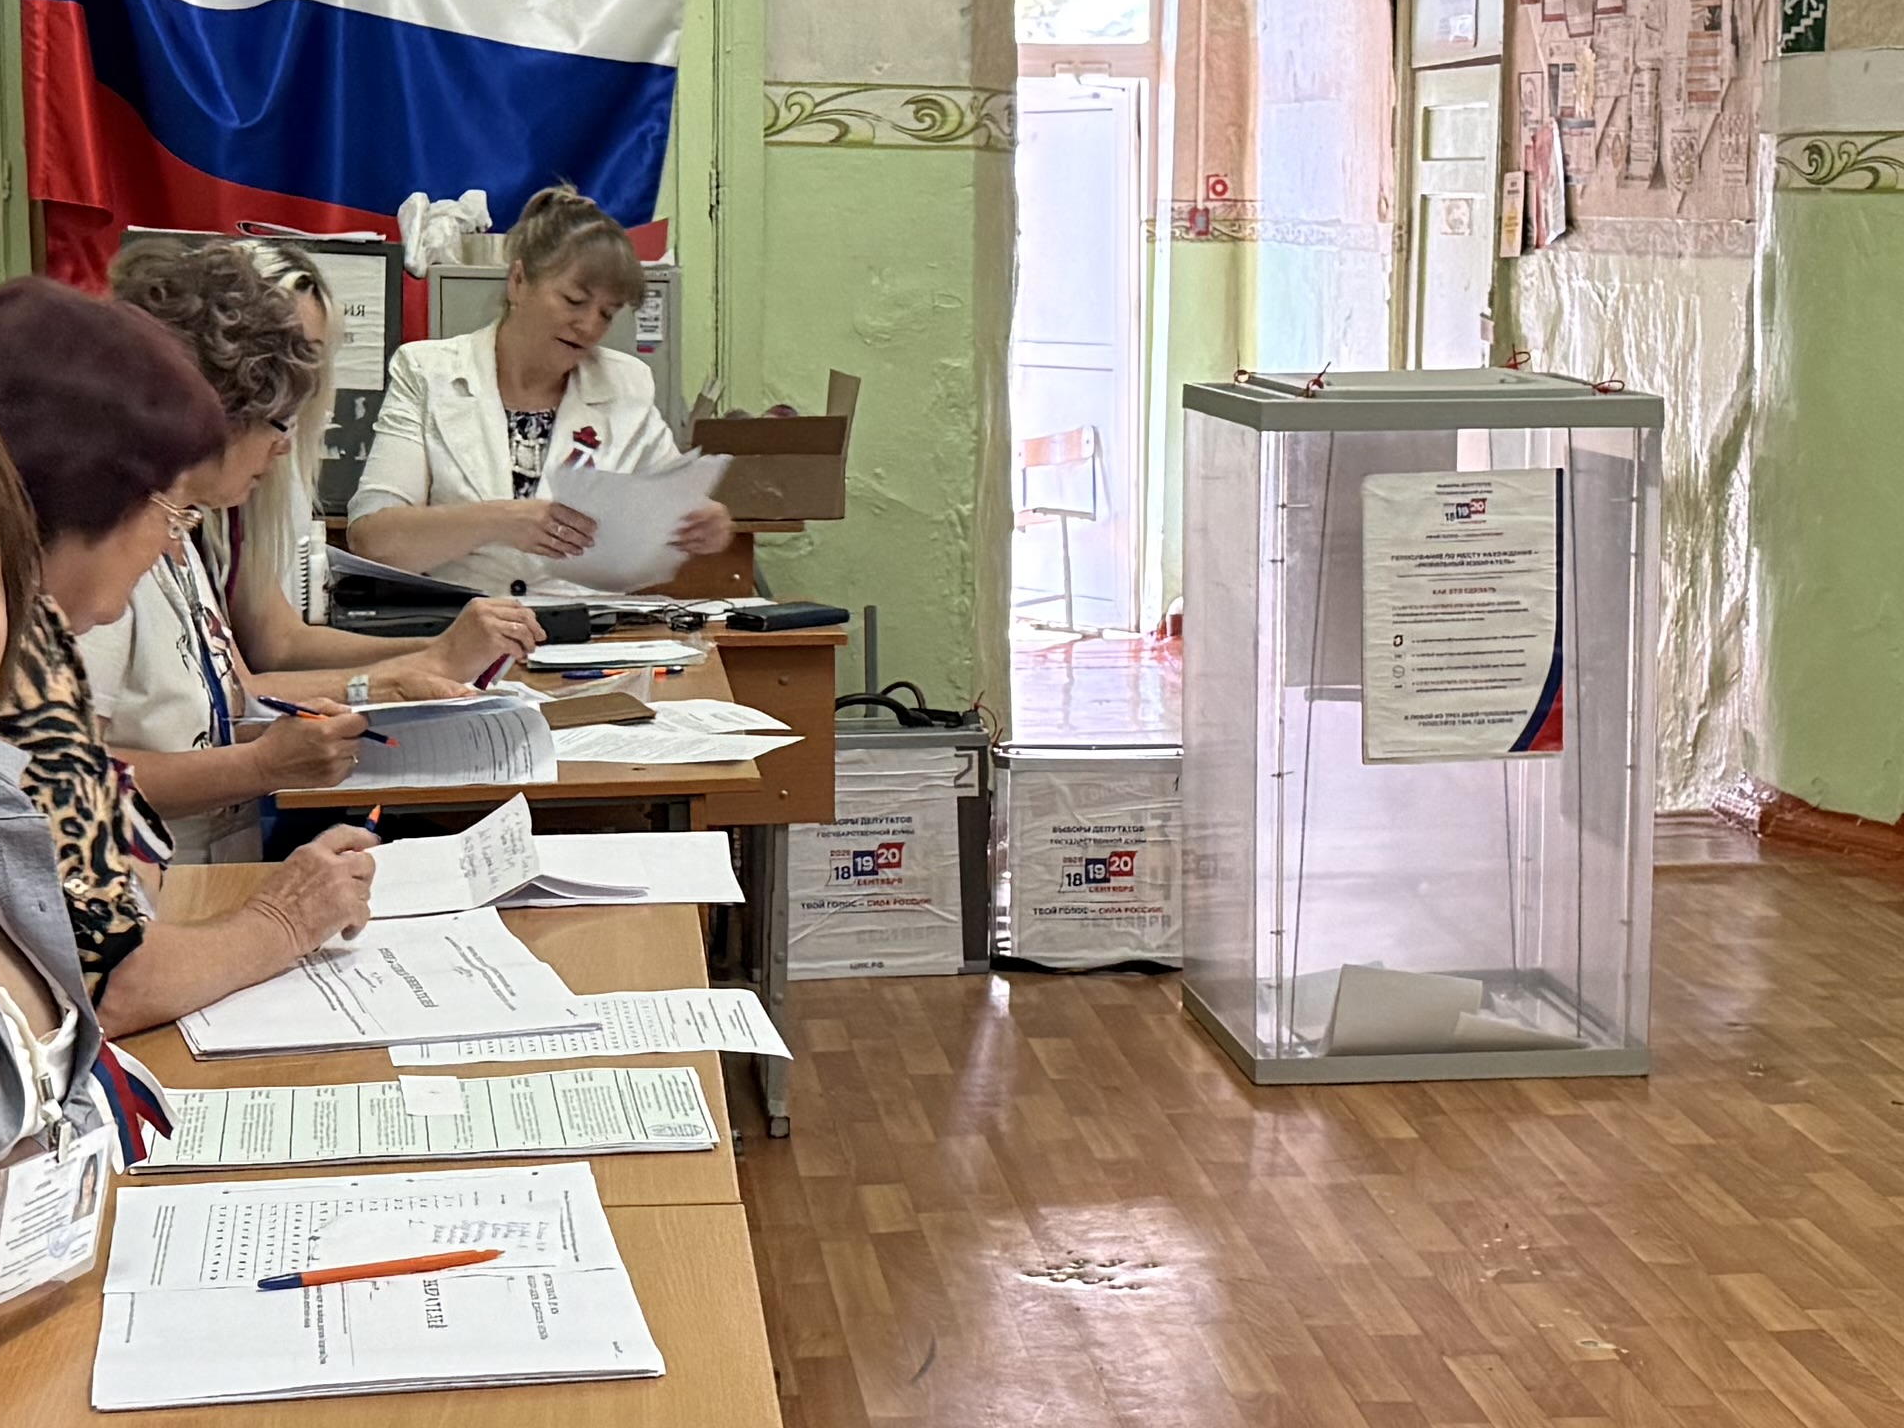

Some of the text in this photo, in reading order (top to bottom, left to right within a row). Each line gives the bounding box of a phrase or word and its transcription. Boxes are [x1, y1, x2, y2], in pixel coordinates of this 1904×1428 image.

[953, 753, 975, 788] 2
[861, 816, 913, 825] ДЕПУТАТОВ
[833, 848, 900, 881] 18 19 20
[1065, 856, 1132, 887] 18 19 20
[801, 900, 826, 910] ТВОЙ
